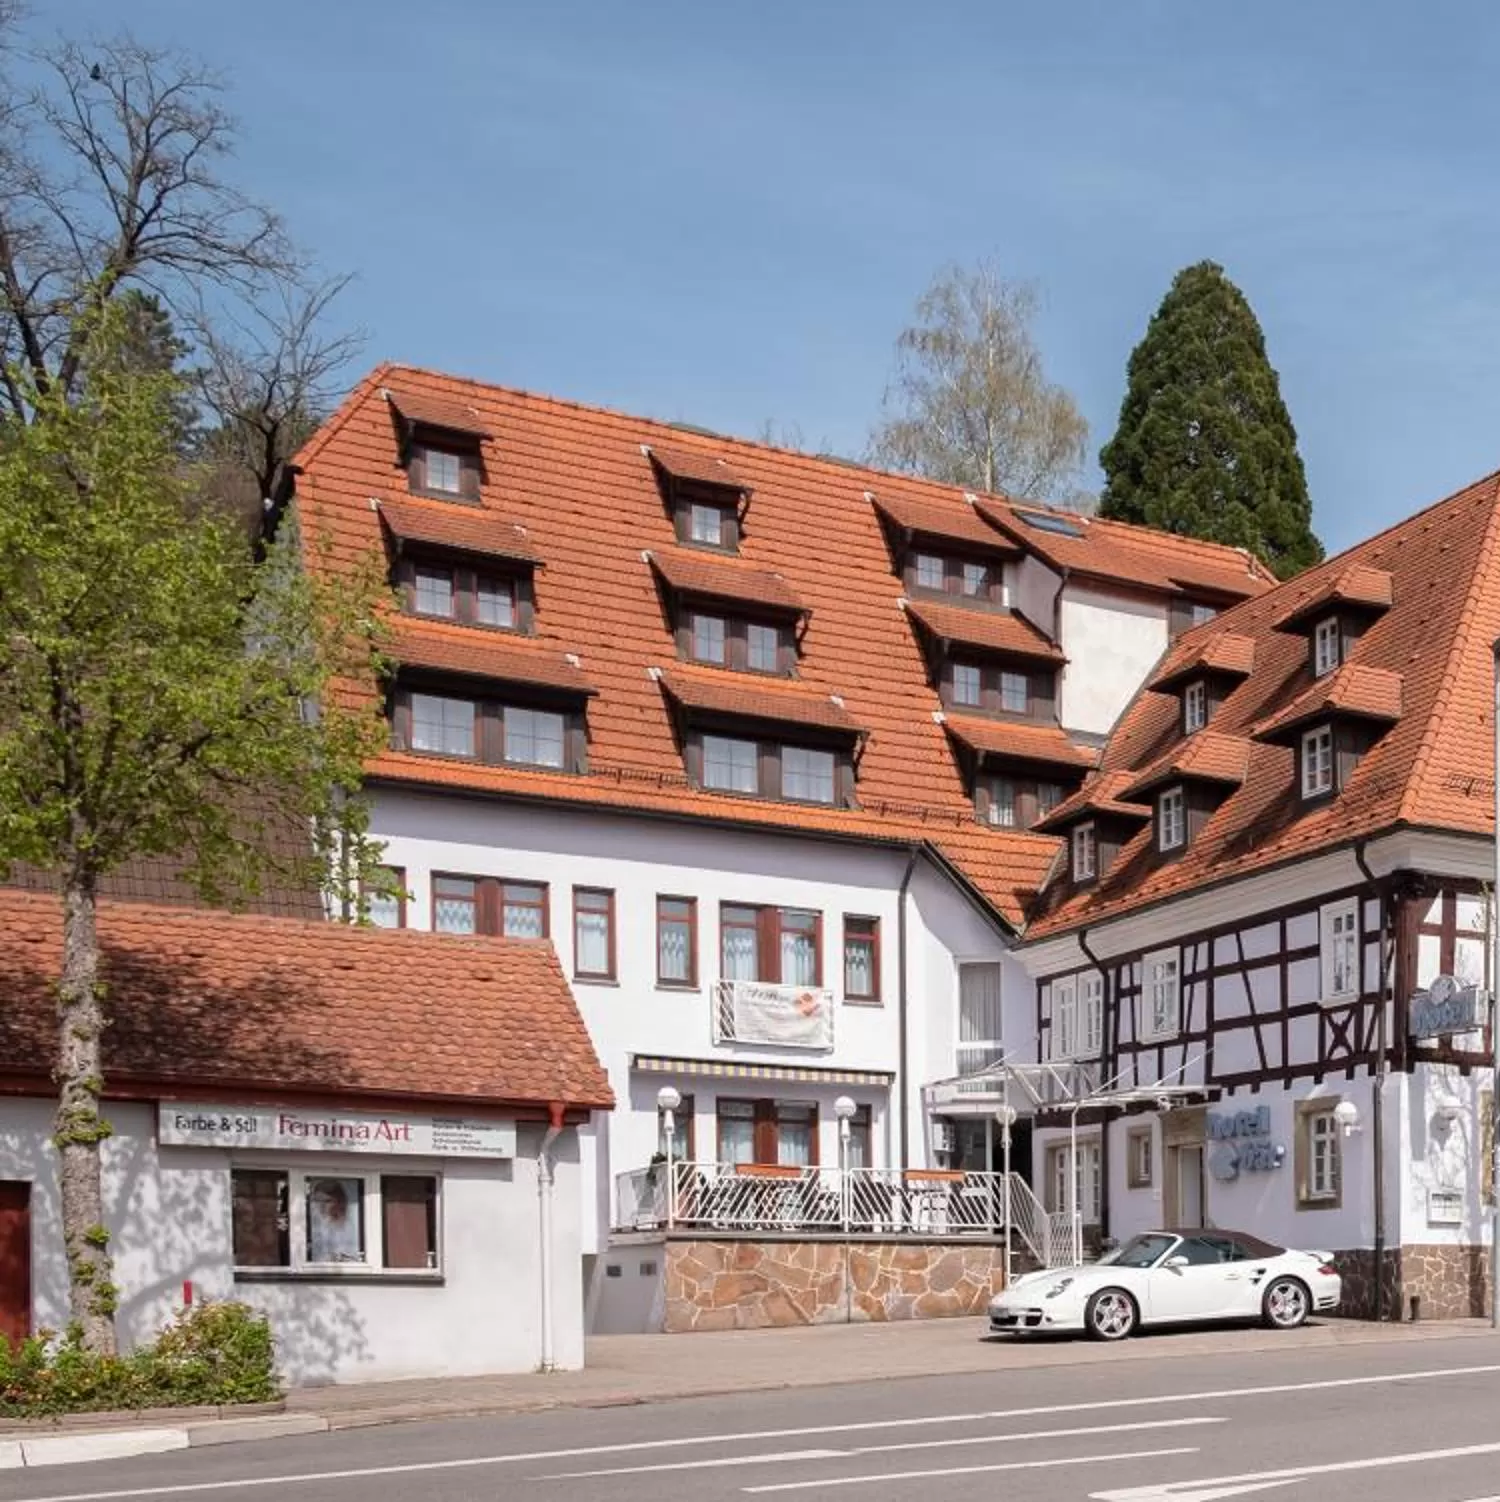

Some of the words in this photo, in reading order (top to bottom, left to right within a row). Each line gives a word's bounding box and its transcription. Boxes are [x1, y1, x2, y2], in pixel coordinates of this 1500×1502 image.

[174, 1115, 217, 1131] Farbe
[221, 1117, 231, 1132] &
[279, 1113, 369, 1139] Femina
[374, 1119, 413, 1141] Art
